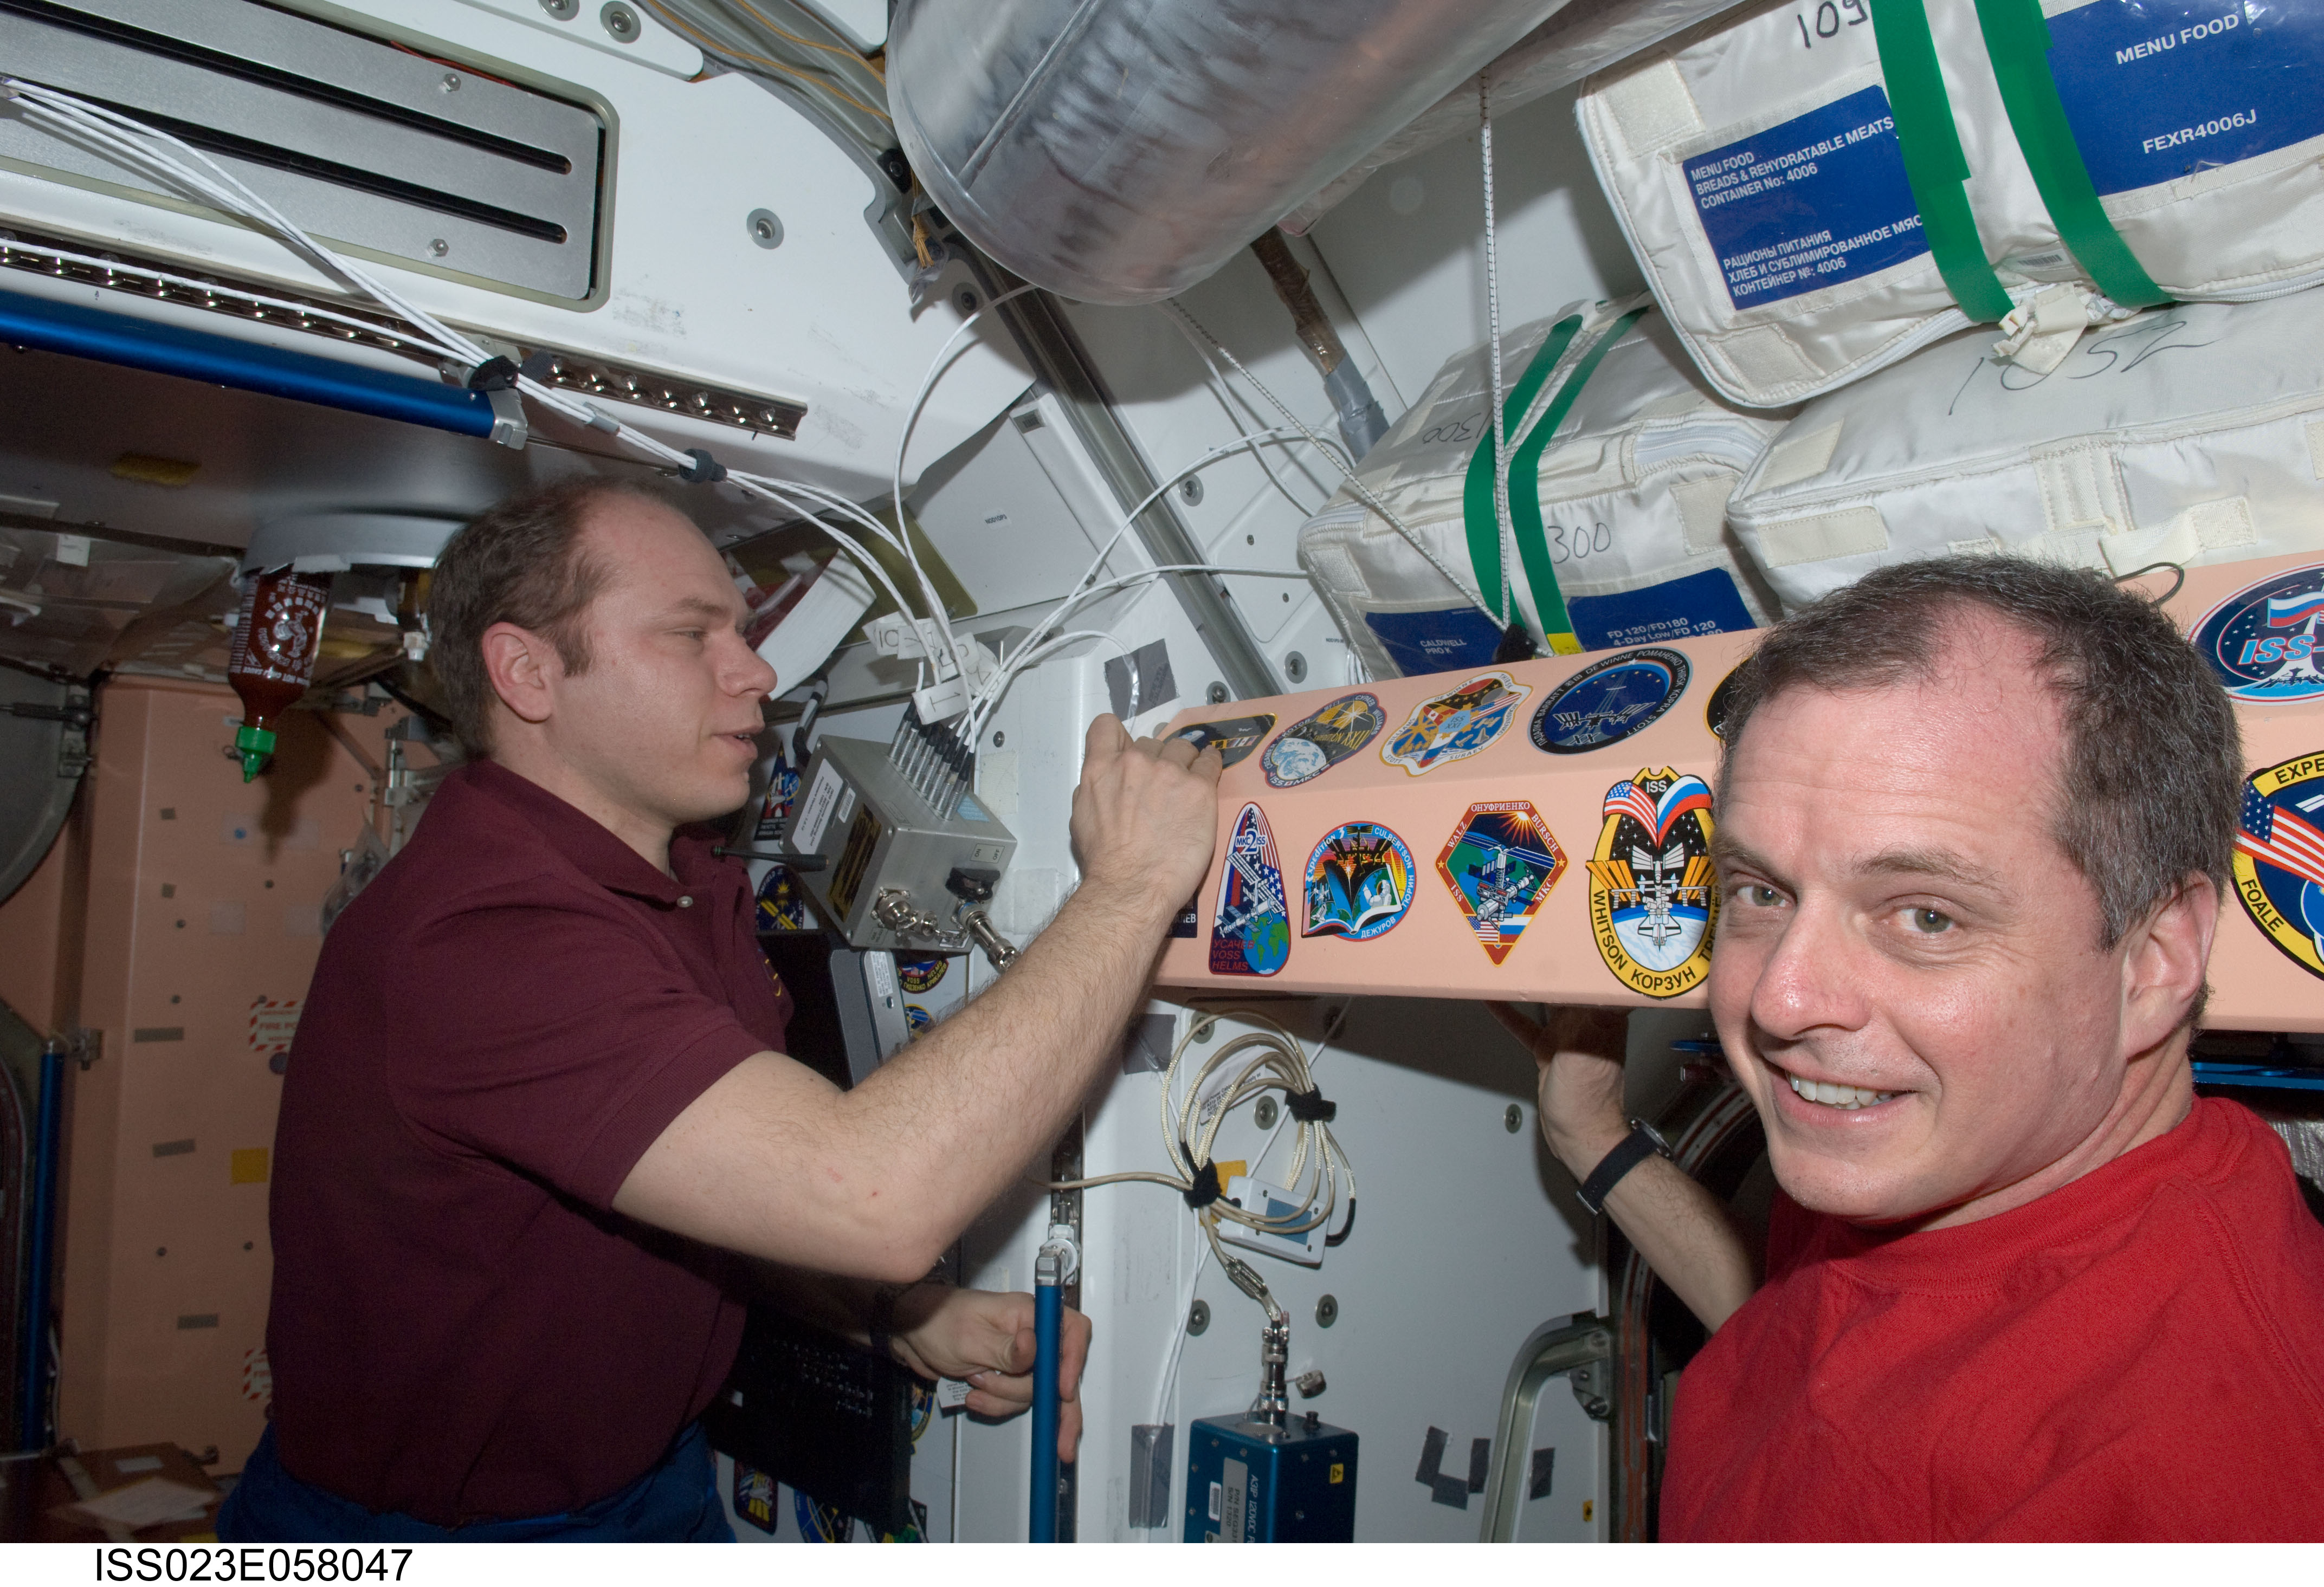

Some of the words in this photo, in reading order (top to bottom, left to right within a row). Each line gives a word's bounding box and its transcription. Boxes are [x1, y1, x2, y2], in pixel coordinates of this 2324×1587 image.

[2115, 35, 2175, 64] MENU
[2180, 14, 2240, 44] FOOD
[2142, 109, 2257, 154] FEXR4006J
[1691, 161, 1720, 182] MENU
[1722, 152, 1754, 171] FOOD
[1696, 173, 1739, 195] BREADS
[1740, 171, 1749, 183] &
[1750, 137, 1845, 179] REHYDRATABLE
[1845, 116, 1894, 144] MEATS
[1701, 182, 1764, 209] CONTAINER
[1786, 163, 1818, 182] 4006
[1723, 247, 1776, 270] РАЦИОНЫ
[1777, 230, 1832, 252] ПИТАНИЯ
[1729, 263, 1756, 283] ХЛЕБ
[1758, 261, 1766, 274] И
[1768, 227, 1892, 273] СУБЛИМИРОВАННОЕ
[1733, 272, 1796, 297] КОНТЕЙНЕР
[1817, 257, 1846, 274] 4006
[1419, 639, 1467, 647] CALDWELL
[1607, 630, 1623, 639] FD
[1613, 636, 1646, 646] 4-Day
[1693, 620, 1716, 632] 120
[1585, 664, 1599, 675] DE
[1600, 652, 1633, 668] WINNE
[1445, 679, 1474, 698] WINNE
[1537, 688, 1564, 717] BARRATT
[1626, 715, 1657, 736] STOTT
[1385, 754, 1403, 765] STOTT
[1449, 746, 1484, 760] SURAEV
[1270, 775, 1283, 786] ISS
[1293, 770, 1321, 785] МКС
[1646, 781, 1667, 793] ISS
[1471, 802, 1530, 812] ОНУФРИЕНКО
[1244, 830, 1258, 851] 2
[1256, 836, 1266, 847] ISS
[1338, 827, 1345, 838] 3
[1447, 821, 1467, 849] WALZ
[1531, 813, 1559, 853] BURSCH
[974, 848, 982, 858] ON
[1374, 827, 1412, 869] CULBERTSON
[1402, 875, 1413, 908] ТЮРИН
[1450, 884, 1463, 902] ISS
[1535, 878, 1554, 904] МКС
[2241, 879, 2284, 932] FOALE
[1360, 917, 1397, 939] ДЕЖУРОВ
[1593, 889, 1628, 970] WHITSON
[1213, 939, 1255, 950] УСАЧЕВ
[1213, 950, 1241, 960] VOSS
[927, 960, 942, 979] HELMS
[1212, 961, 1249, 971] HELMS
[1631, 966, 1696, 991] КОРЗУН
[1251, 1474, 1260, 1498] A31P
